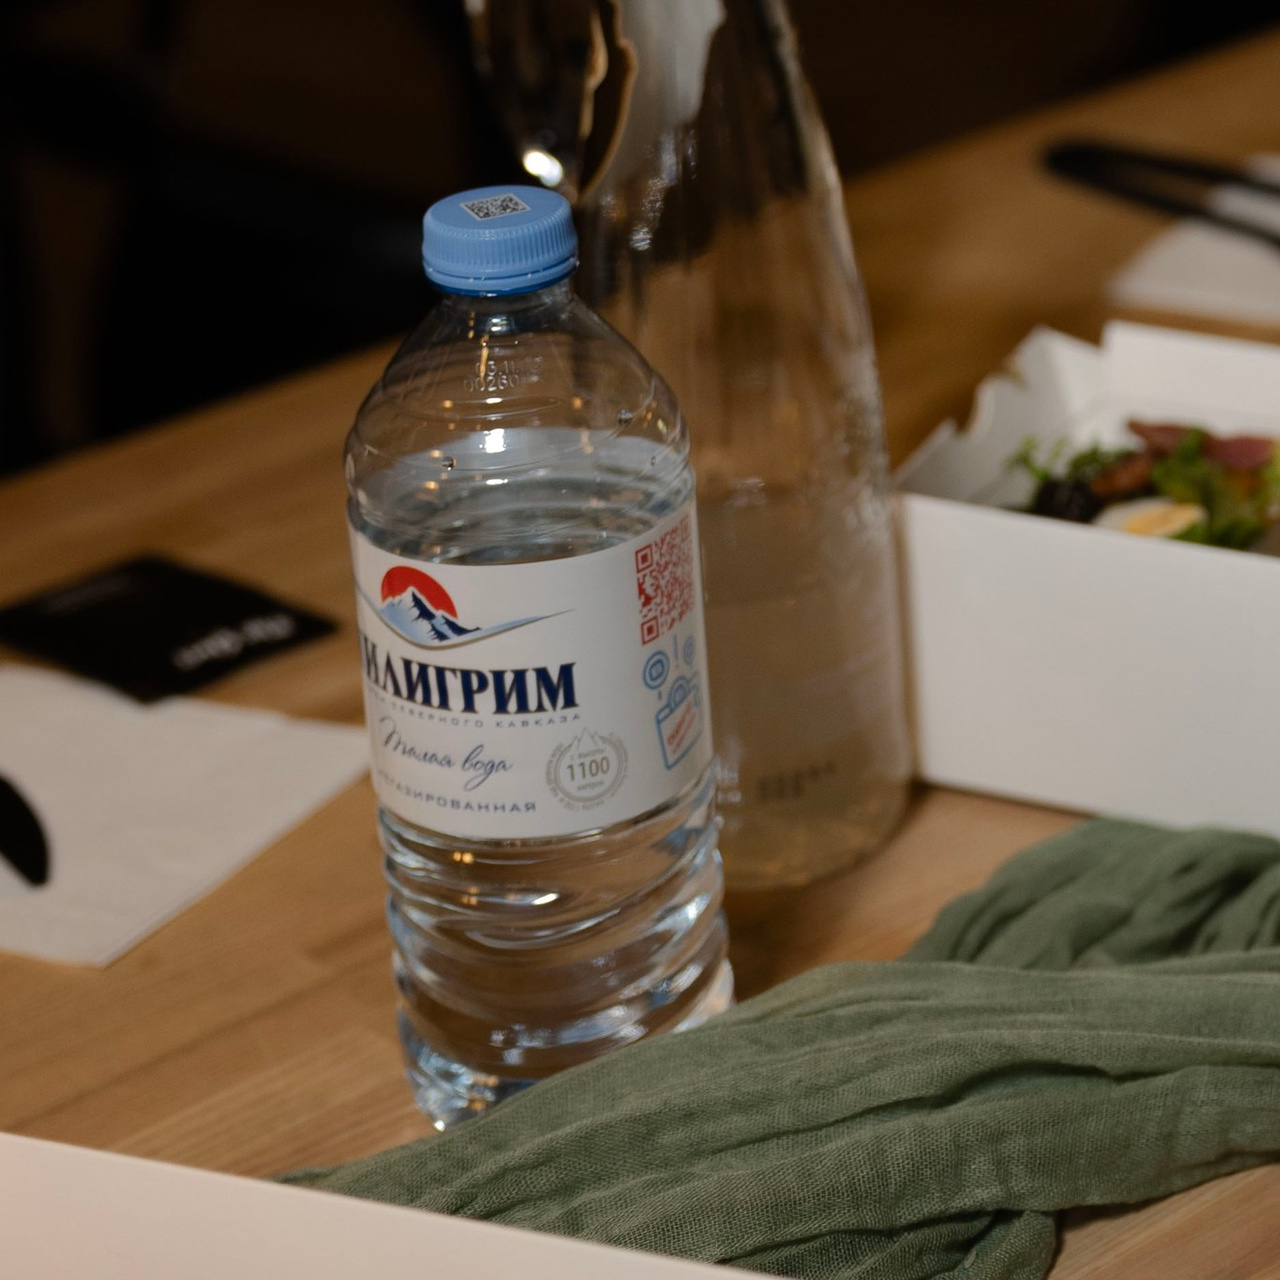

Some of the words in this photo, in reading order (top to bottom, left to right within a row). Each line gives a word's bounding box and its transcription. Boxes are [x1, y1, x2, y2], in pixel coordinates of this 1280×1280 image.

[363, 634, 581, 715] ИЛИГРИМ
[495, 713, 581, 728] КАВКАЗА
[461, 743, 514, 793] вода
[565, 755, 612, 783] 1100
